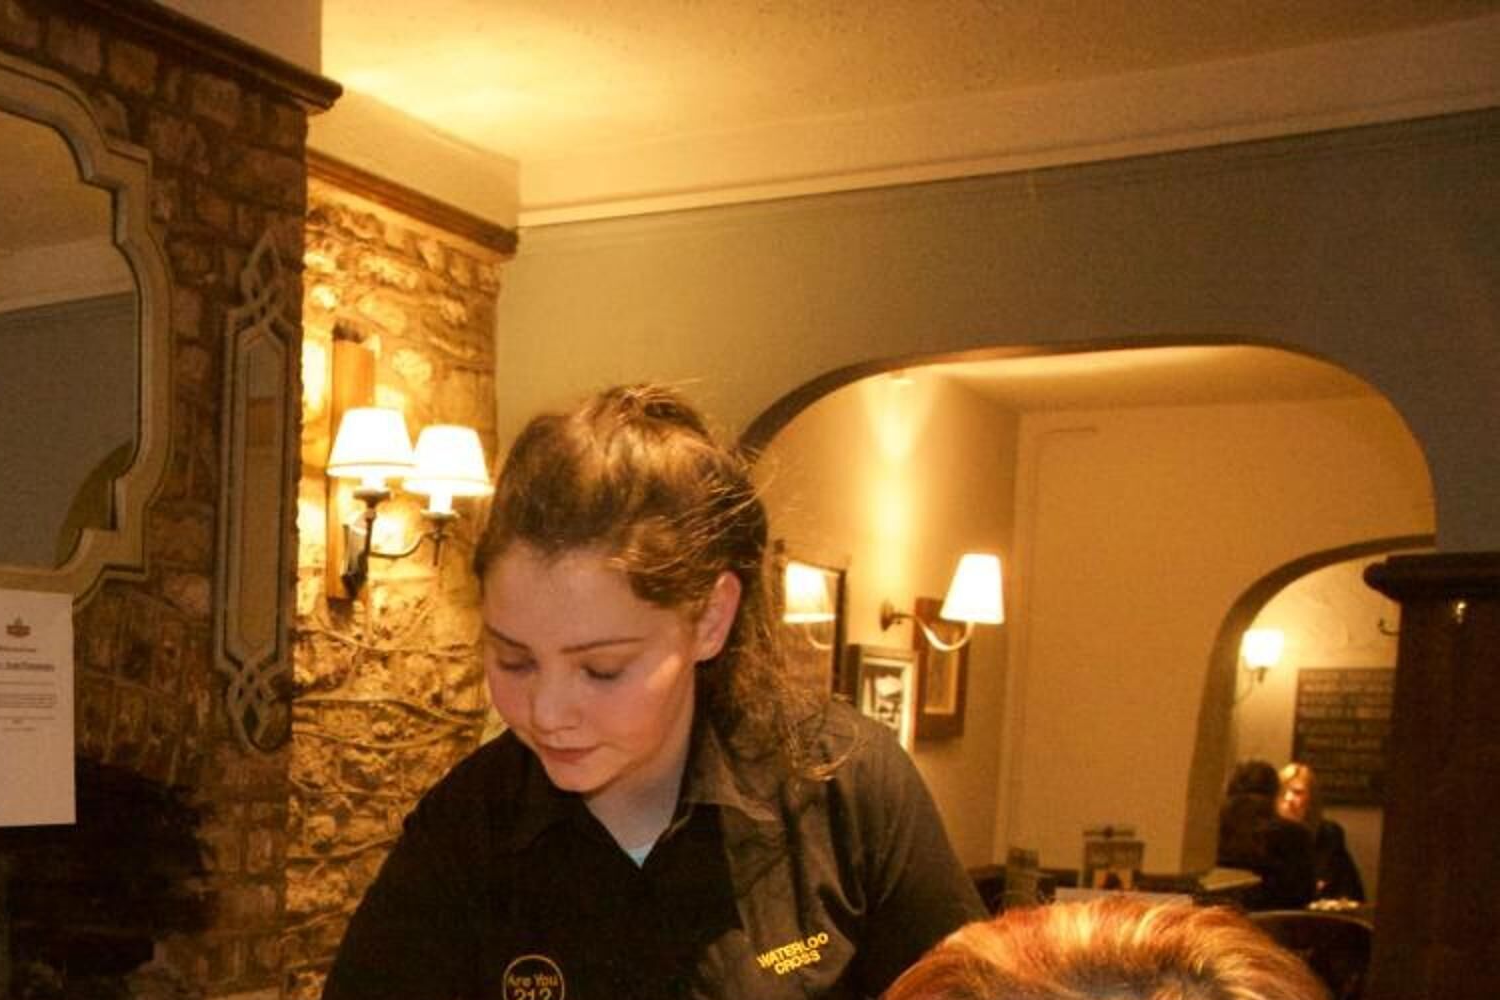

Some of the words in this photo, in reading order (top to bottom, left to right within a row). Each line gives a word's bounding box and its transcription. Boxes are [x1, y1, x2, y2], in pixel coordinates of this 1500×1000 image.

[756, 931, 829, 968] WATERLOO
[774, 950, 820, 974] CROSS
[507, 975, 532, 988] Are
